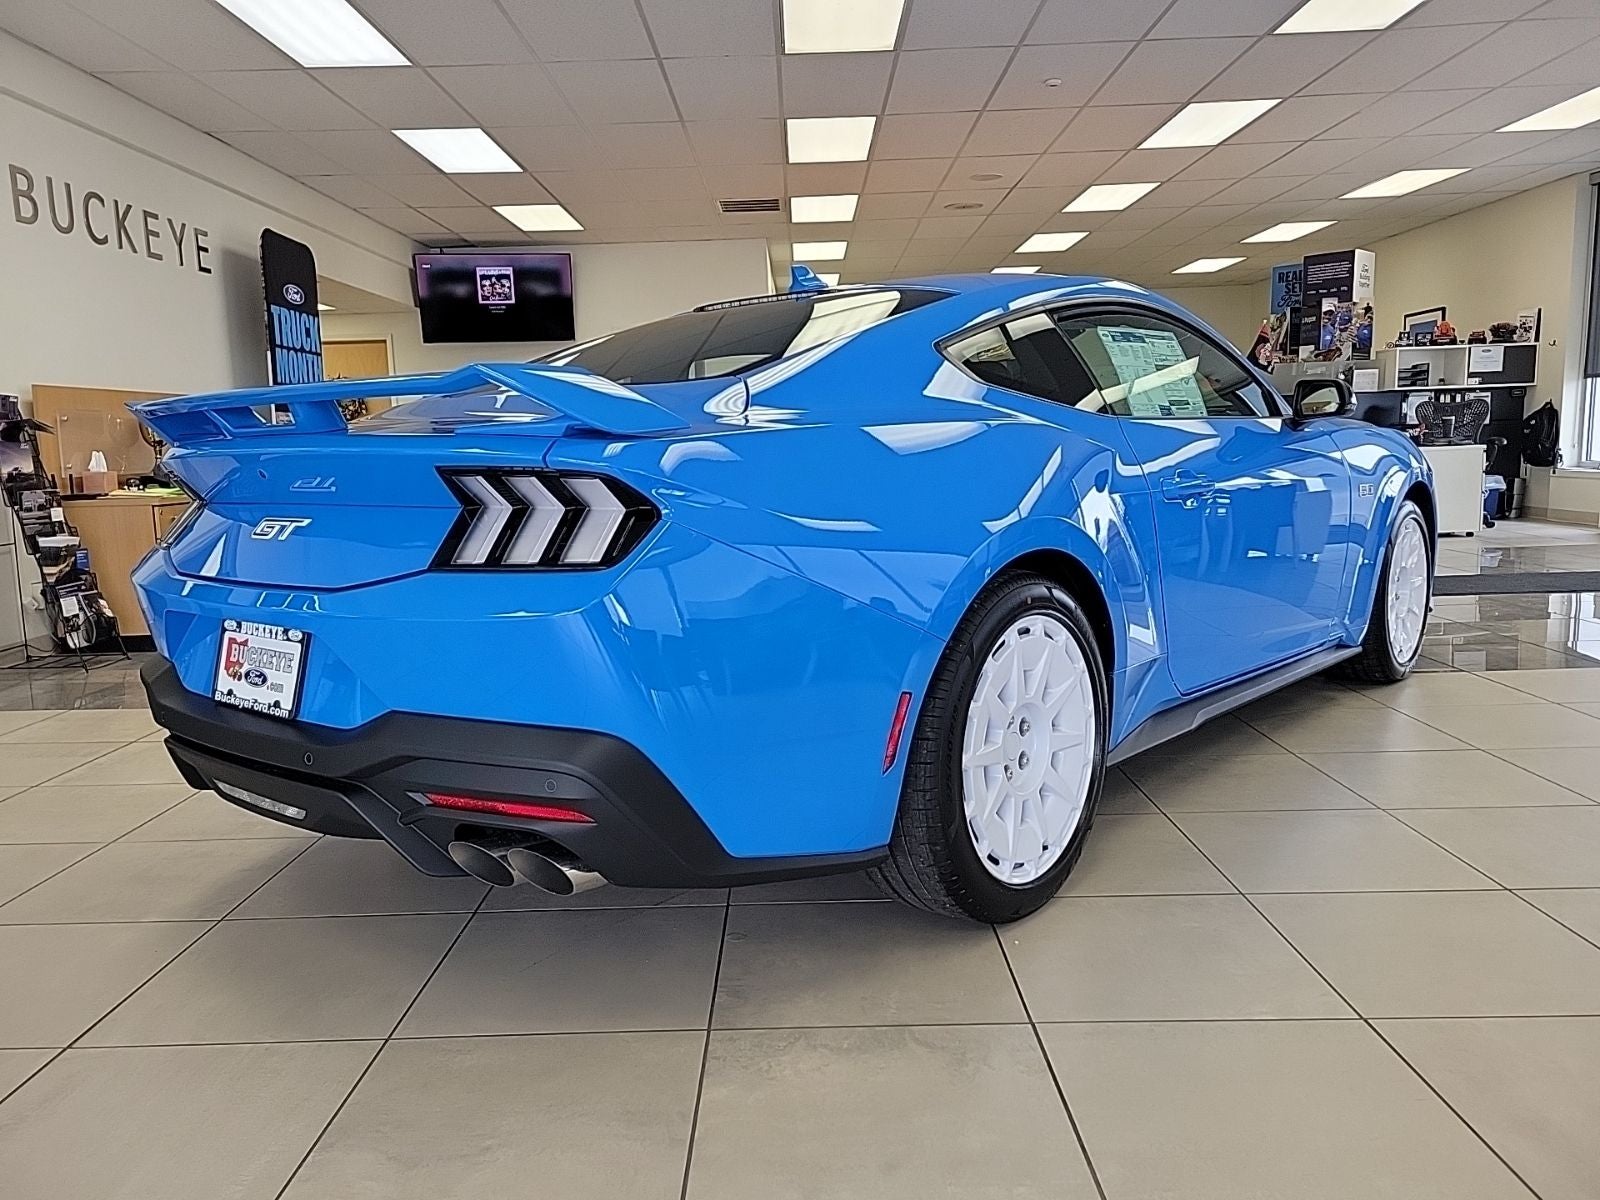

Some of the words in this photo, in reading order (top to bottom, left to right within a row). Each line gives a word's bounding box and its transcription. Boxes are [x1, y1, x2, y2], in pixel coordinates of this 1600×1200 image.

[9, 163, 212, 274] BUCKEYE
[285, 285, 302, 300] Ford
[270, 304, 321, 353] TRUCK
[275, 347, 322, 383] MONTH
[251, 517, 312, 541] GT
[241, 621, 284, 641] BUCKEYE
[230, 643, 294, 674] BUCKEYE
[246, 669, 266, 686] Ford
[215, 690, 289, 718] BuckeyeFord.com
